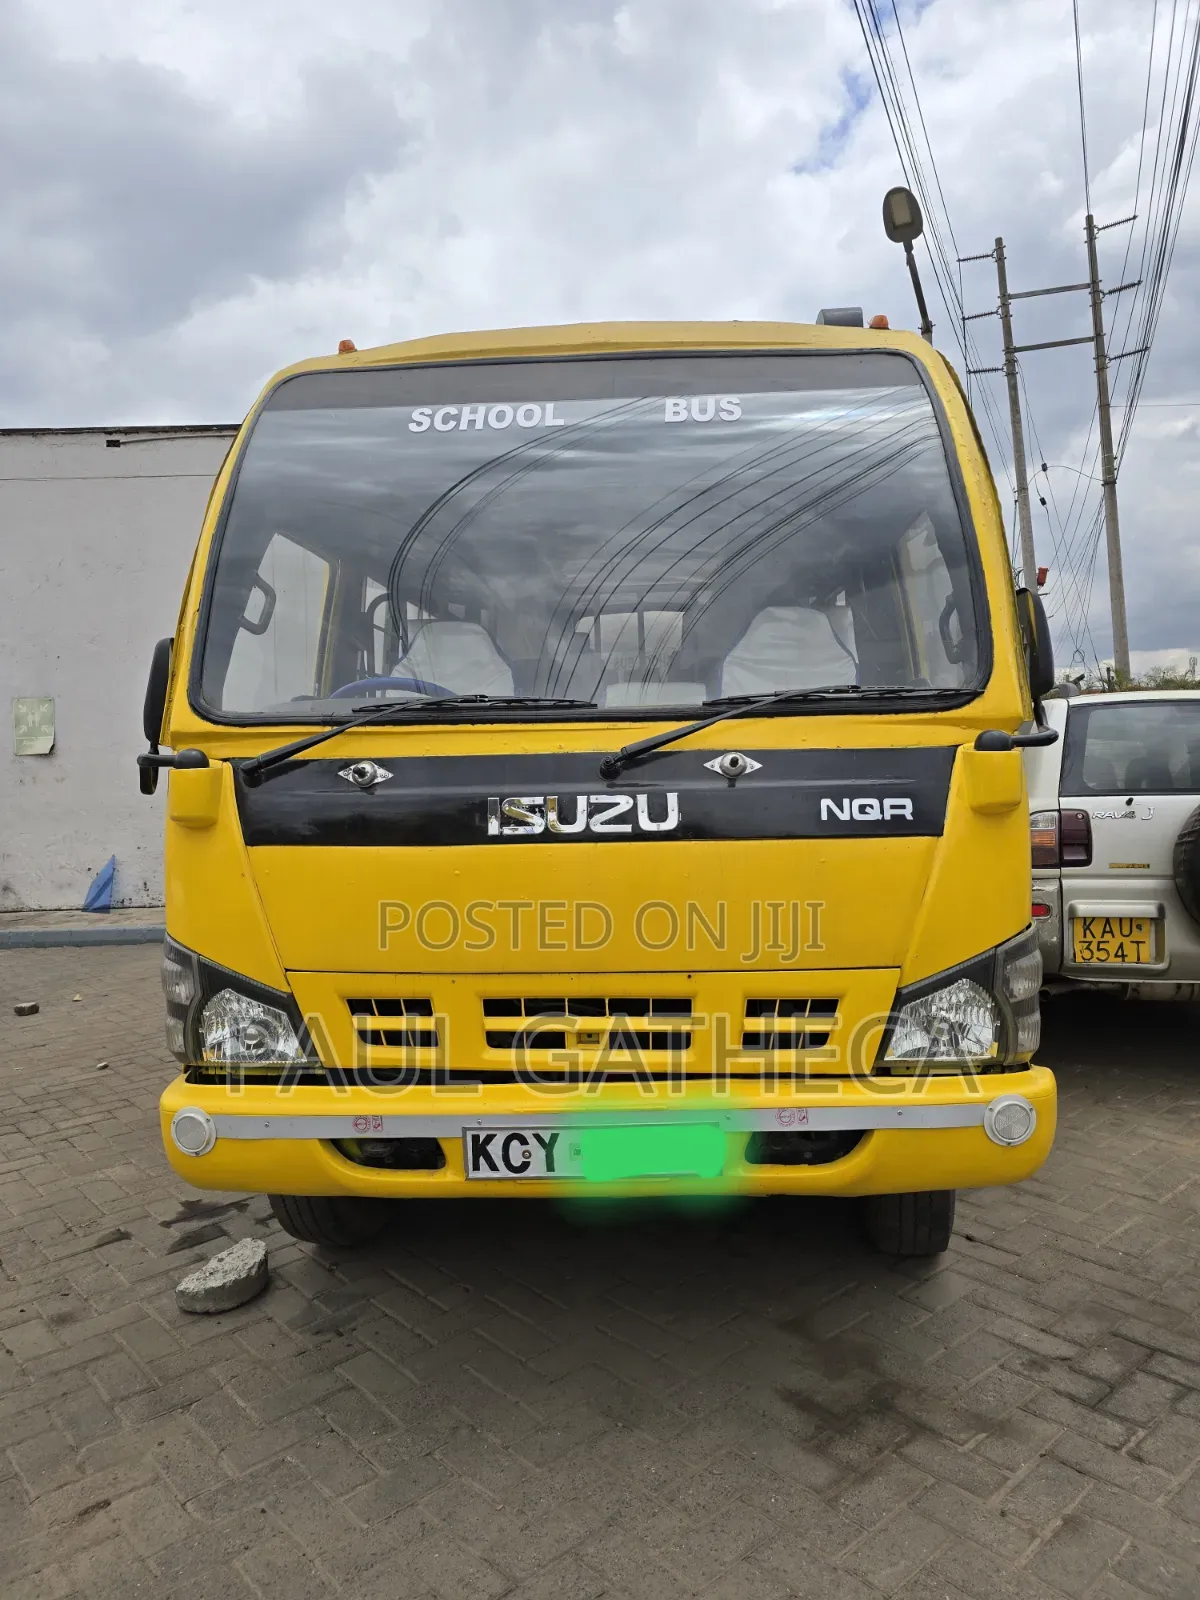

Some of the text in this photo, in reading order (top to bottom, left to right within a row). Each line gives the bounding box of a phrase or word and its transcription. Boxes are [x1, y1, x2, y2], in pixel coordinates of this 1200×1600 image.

[408, 397, 743, 432] SCHOOL BUS
[487, 792, 679, 836] ISUZU
[820, 798, 914, 820] NQR
[1092, 807, 1155, 820] RAV4 J
[1082, 917, 1133, 938] KAU
[1079, 941, 1146, 963] 354T
[471, 1132, 560, 1175] KCY
